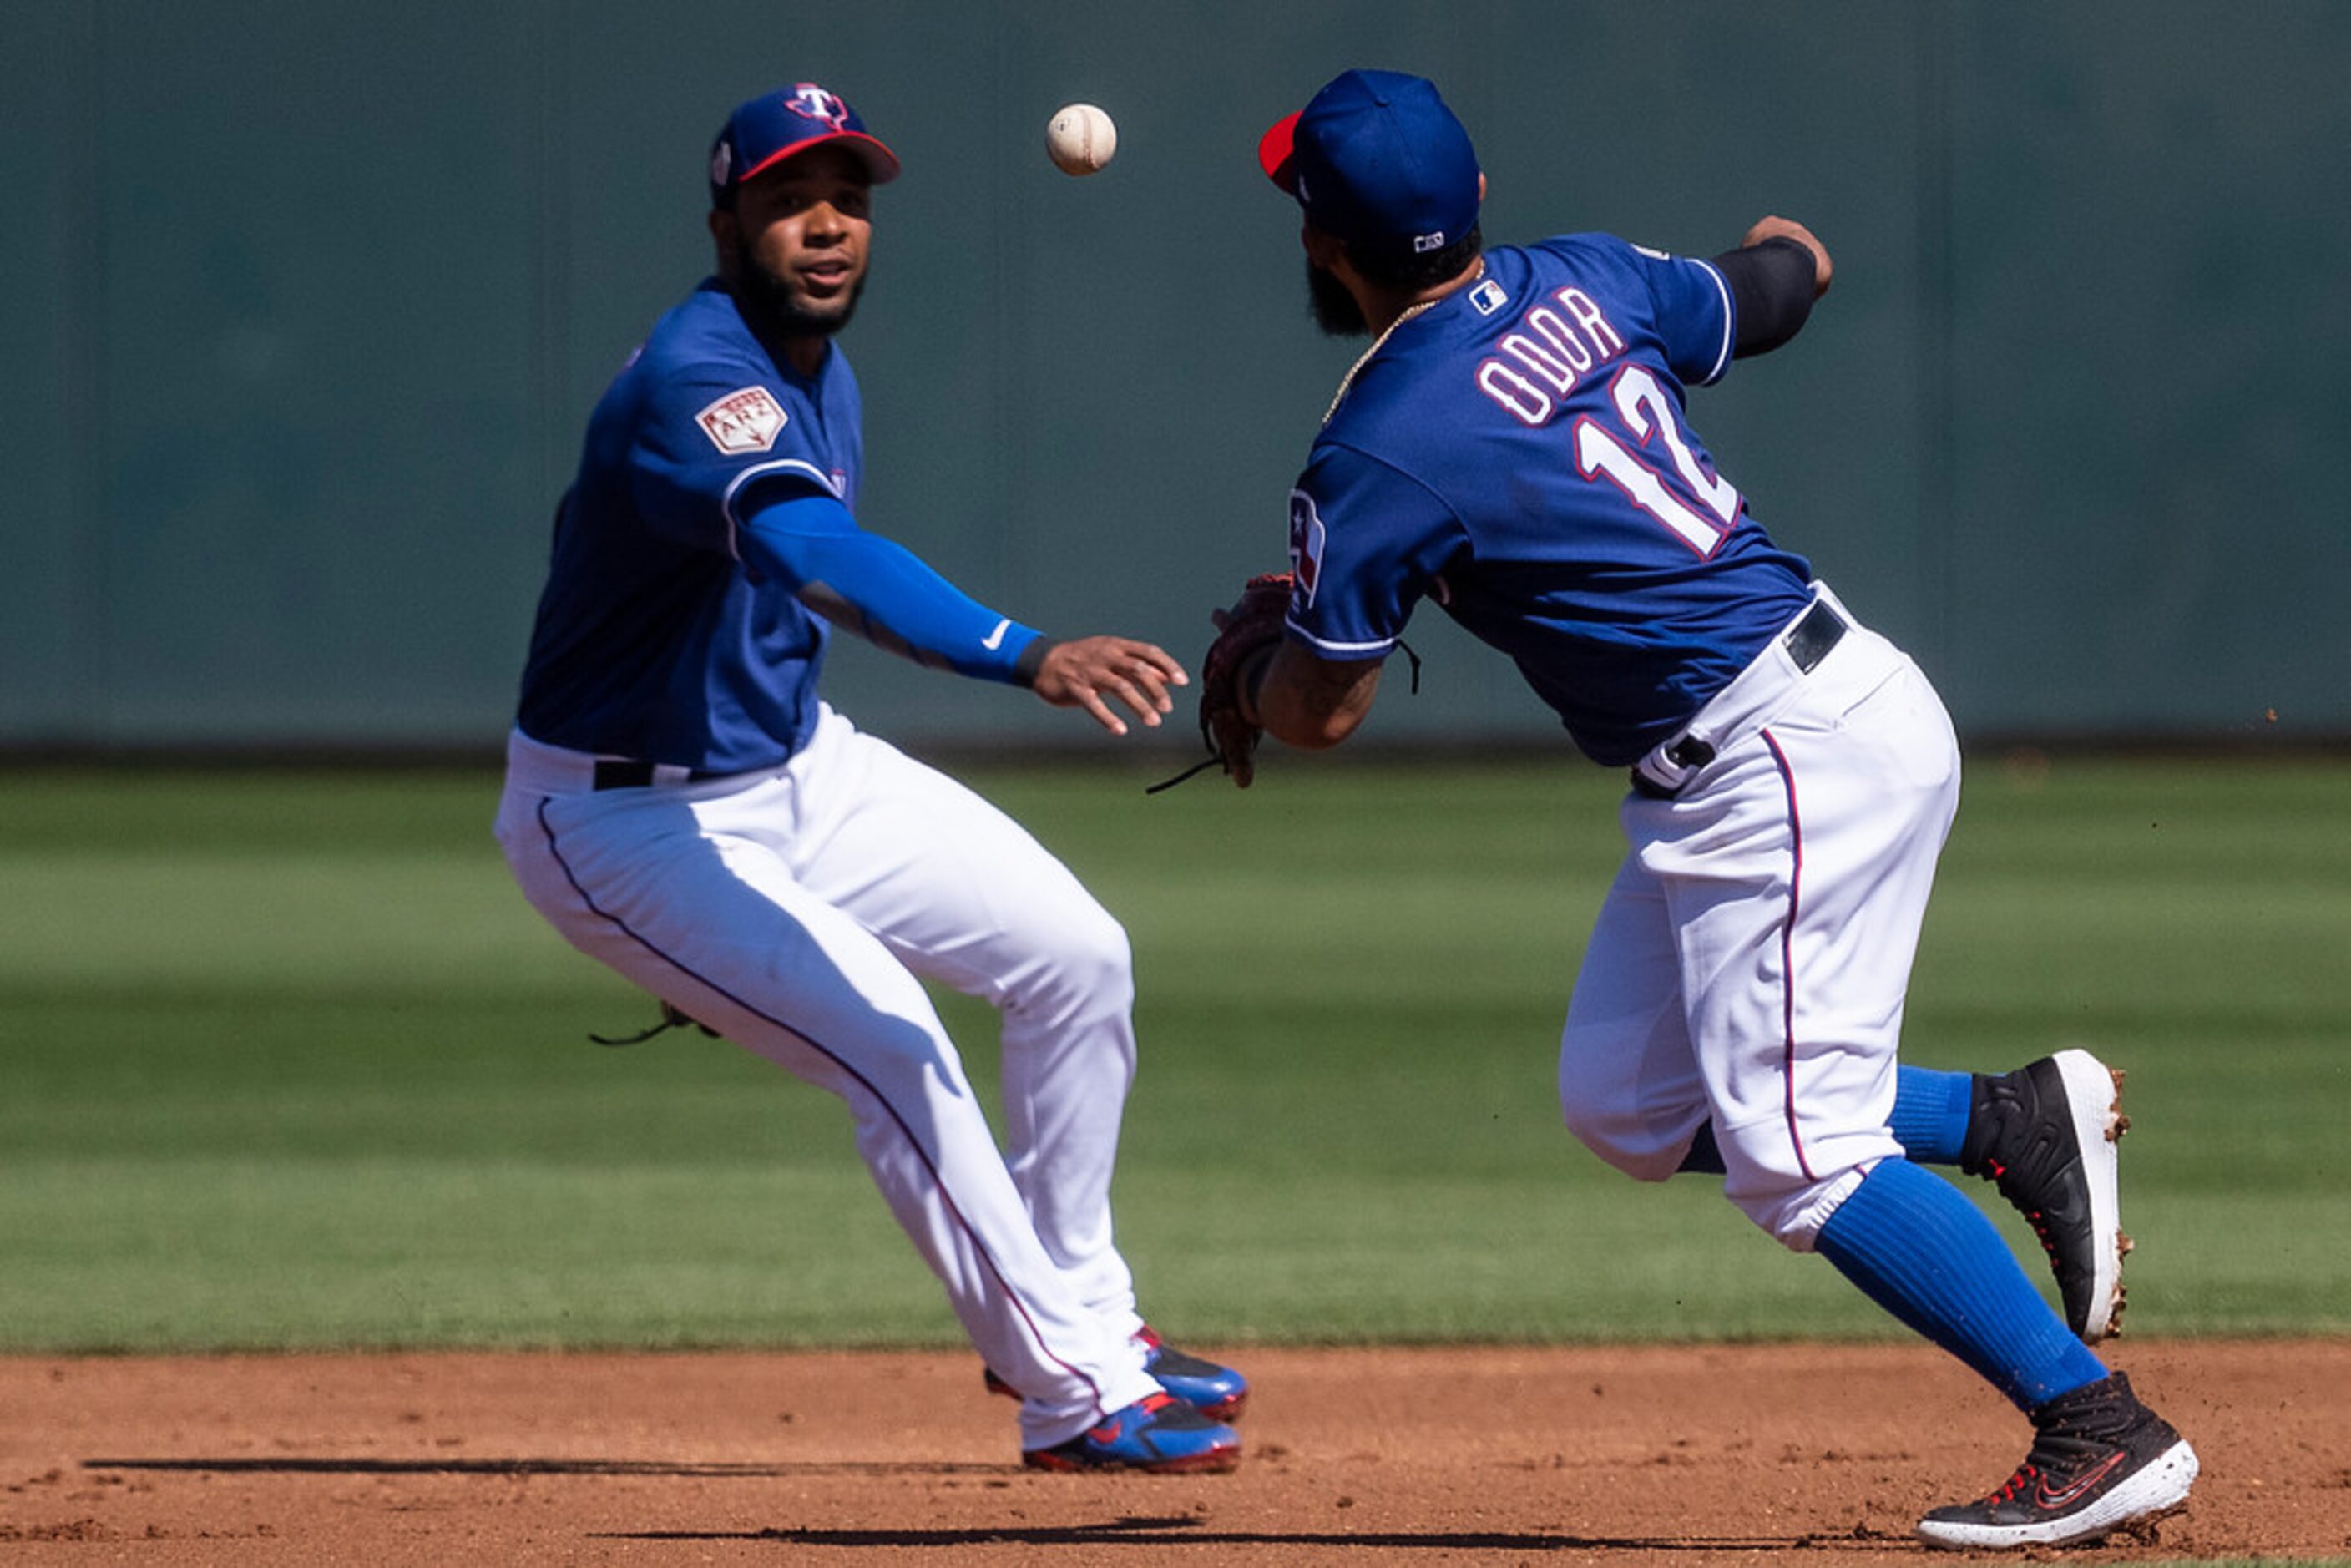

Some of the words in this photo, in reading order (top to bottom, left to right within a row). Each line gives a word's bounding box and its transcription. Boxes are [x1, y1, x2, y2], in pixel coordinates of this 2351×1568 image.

[796, 88, 833, 119] T
[1475, 286, 1628, 427] ODOR
[1573, 361, 1744, 563] 12
